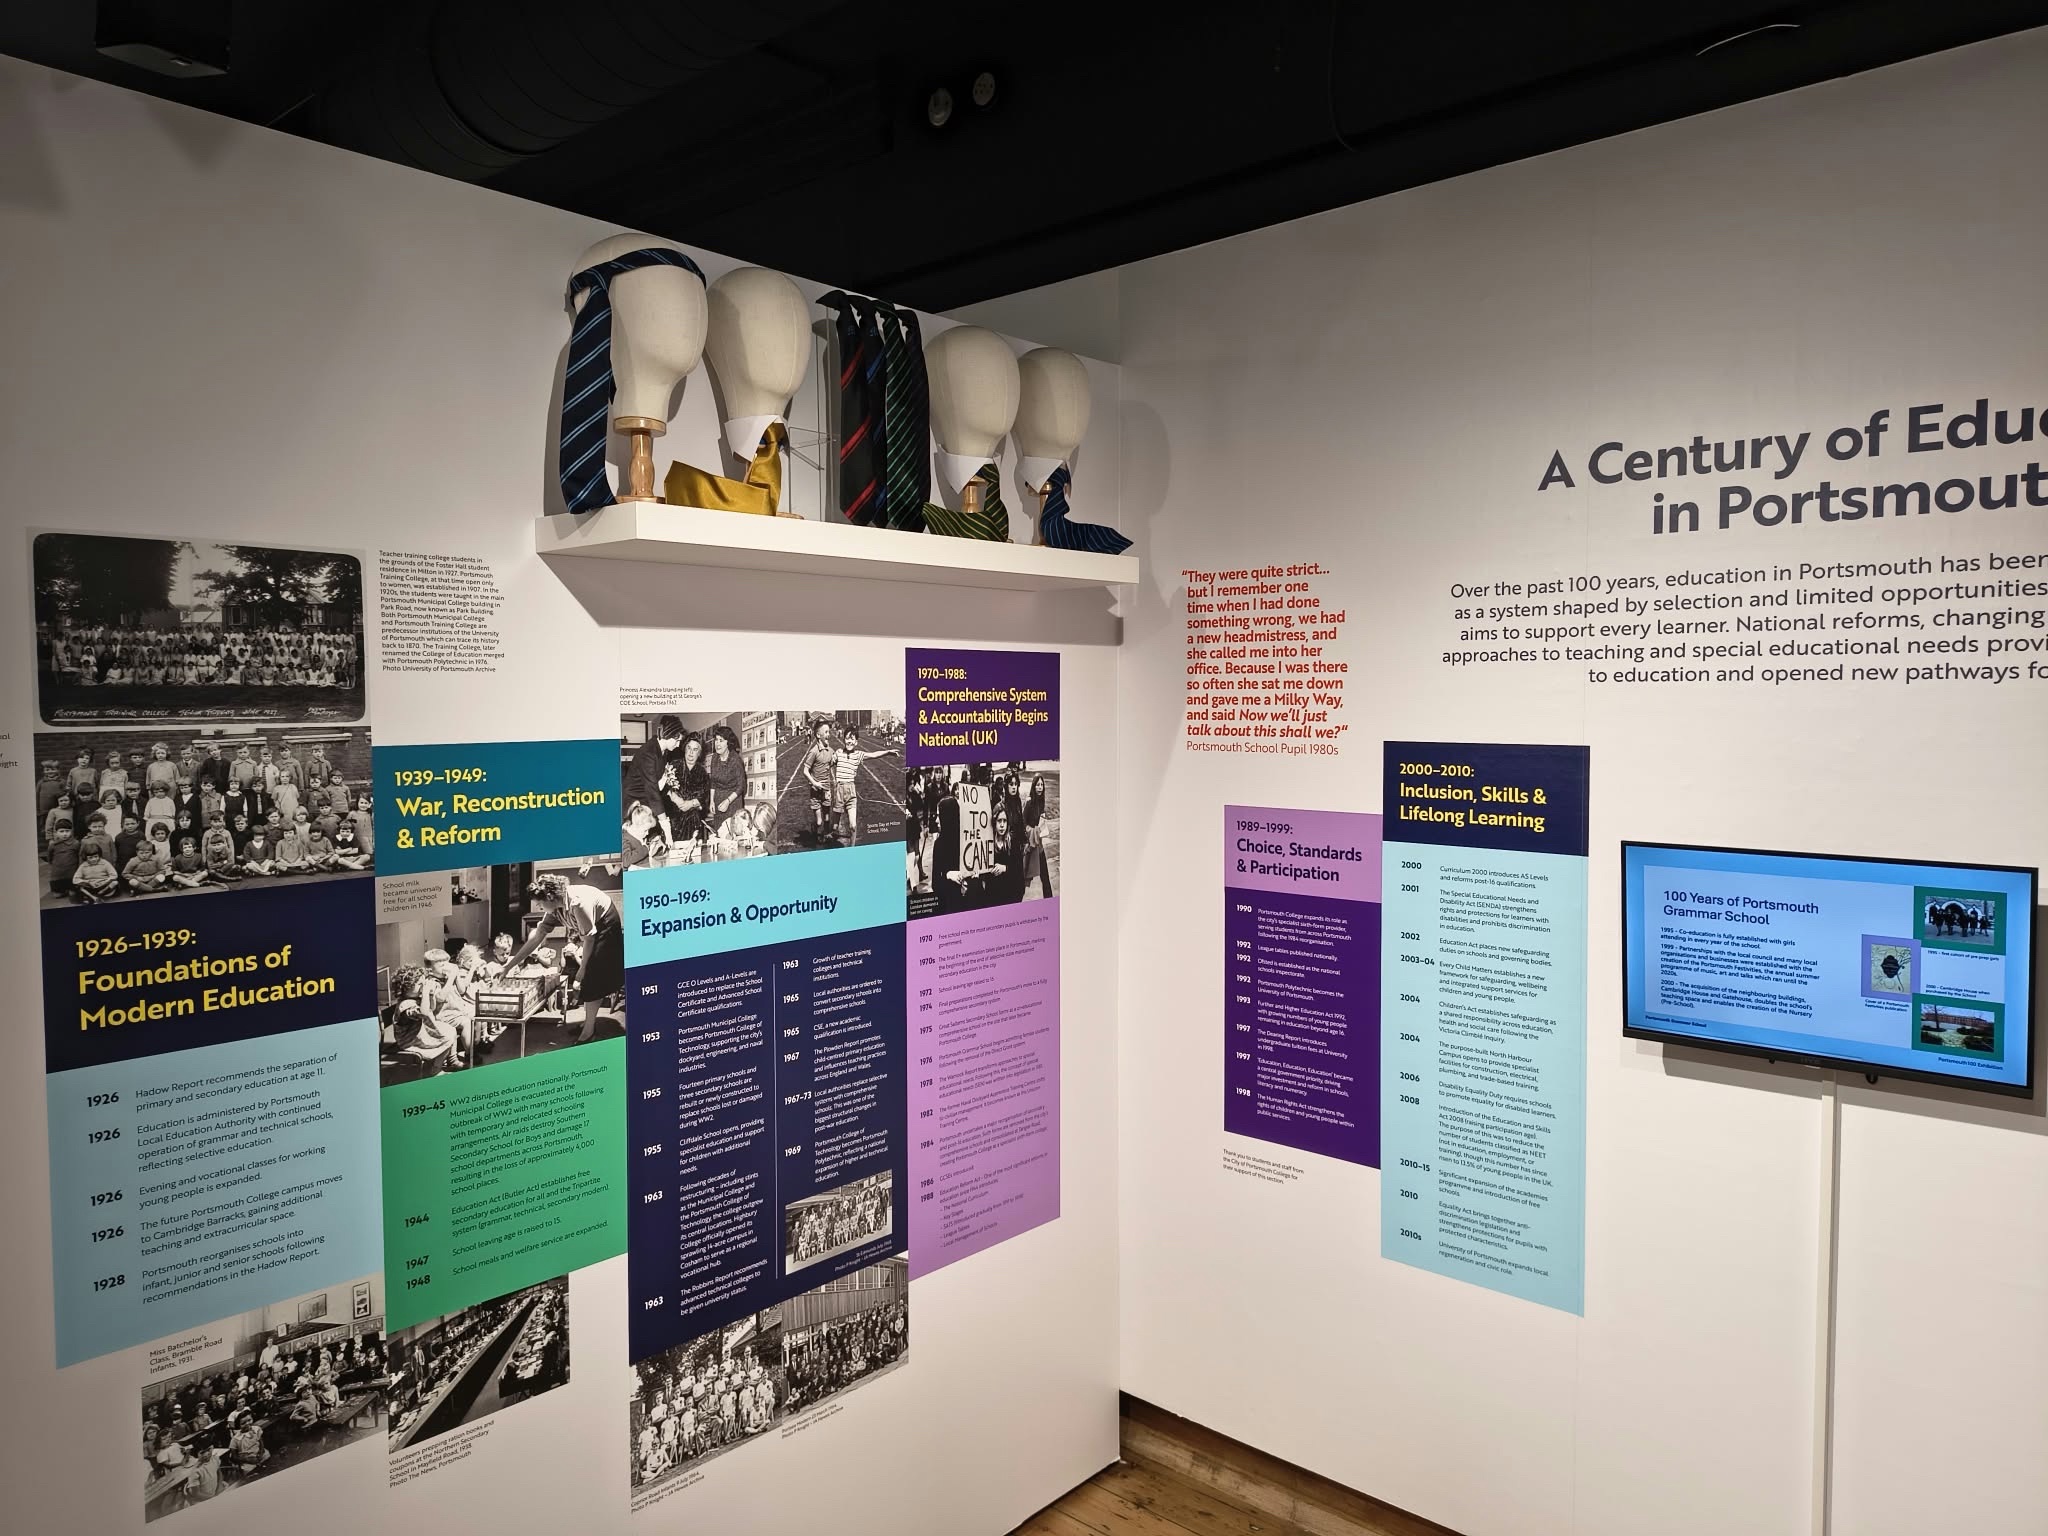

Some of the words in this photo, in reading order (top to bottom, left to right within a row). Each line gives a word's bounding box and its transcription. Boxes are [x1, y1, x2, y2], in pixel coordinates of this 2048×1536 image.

[1538, 450, 1575, 490] A
[1588, 434, 1811, 483] Century
[1826, 410, 1890, 460] of
[1908, 399, 2048, 452] Edu
[1654, 493, 1699, 534] in
[1719, 464, 2048, 527] Portsmout
[1219, 570, 1248, 580] were
[1251, 566, 1283, 581] quite
[1451, 584, 1490, 598] Over
[1494, 582, 1521, 596] the
[1528, 580, 1563, 598] past
[1569, 576, 1601, 592] 100
[1606, 577, 1658, 594] years,
[1666, 568, 1765, 586] education
[1774, 566, 1791, 581] in
[1800, 557, 1931, 579] Portsmouth
[1941, 556, 1980, 572] has
[1188, 586, 1208, 598] but
[1211, 585, 1214, 597] I
[1218, 582, 1282, 596] remember
[1285, 582, 1308, 592] one
[1455, 609, 1470, 619] as
[1476, 608, 1484, 619] a
[1490, 604, 1547, 622] system
[1554, 598, 1618, 618] shaped
[1626, 597, 1648, 616] by
[1654, 594, 1742, 611] selection
[1750, 590, 1788, 607] and
[1797, 586, 1872, 605] limited
[1882, 580, 2048, 605] opportunities
[1188, 615, 1250, 629] something
[1253, 616, 1295, 628] wrong,
[1298, 615, 1317, 624] we
[1321, 610, 1345, 623] had
[1461, 627, 1497, 640] aims
[1502, 627, 1519, 640] to
[1525, 624, 1595, 642] support
[1600, 624, 1651, 639] every
[1658, 620, 1729, 634] learner.
[1737, 614, 1825, 632] National
[1833, 612, 1924, 629] reforms,
[1933, 608, 2045, 629] changing
[1187, 635, 1193, 644] a
[1197, 634, 1221, 644] new
[1224, 630, 1308, 642] headmistress,
[1312, 627, 1336, 640] and
[918, 668, 966, 679] 1970–1988:
[1187, 681, 1199, 690] so
[1203, 678, 1234, 690] often
[1238, 677, 1258, 690] she
[1262, 678, 1280, 690] sat
[1284, 680, 1303, 689] me
[1306, 677, 1343, 689] down
[919, 687, 1007, 704] Comprehensive
[1010, 688, 1046, 705] System
[919, 710, 928, 724] &
[930, 709, 1012, 726] Accountability
[1015, 709, 1048, 725] Begins
[919, 732, 969, 746] National
[972, 730, 997, 746] (UK)
[1187, 741, 1242, 752] Portsmouth
[1245, 742, 1278, 753] School
[1281, 743, 1306, 756] Pupil
[1310, 744, 1338, 755] 1980s
[395, 768, 486, 786] 1939–1949:
[1400, 764, 1474, 777] 2000–2010:
[396, 797, 446, 816] War,
[454, 788, 604, 813] Reconstruction
[963, 786, 978, 804] NO
[1401, 783, 1477, 803] Inclusion,
[1482, 786, 1528, 803] Skills
[1533, 789, 1546, 804] &
[969, 811, 988, 829] TO
[1237, 821, 1292, 834] 1989–1999:
[1400, 806, 1464, 827] Lifelong
[1470, 809, 1544, 832] Learning
[397, 830, 414, 848] &
[422, 826, 500, 846] Reform
[964, 829, 981, 840] THE
[963, 840, 994, 871] CANE
[1237, 838, 1285, 857] Choice,
[1290, 842, 1362, 861] Standards
[1237, 858, 1246, 872] &
[1251, 860, 1339, 881] Participation
[1402, 861, 1422, 869] 2000
[1440, 866, 1471, 874] Curriculum
[640, 890, 710, 909] 1950–1969:
[1664, 891, 1687, 902] 100
[1690, 892, 1724, 905] Years
[1727, 896, 1740, 906] of
[1743, 897, 1818, 913] Portsmouth
[642, 912, 726, 938] Expansion
[730, 907, 742, 923] &
[746, 896, 837, 923] Opportunity
[1664, 905, 1722, 920] Grammar
[1725, 911, 1770, 924] School
[76, 930, 196, 957] 1926–1939:
[920, 935, 932, 943] 1970
[80, 956, 257, 993] Foundations
[265, 945, 291, 968] of
[678, 981, 690, 989] GCE
[697, 977, 713, 985] Levels
[726, 971, 747, 980] A-Levels
[642, 985, 657, 995] 1951
[81, 999, 194, 1030] Modern
[204, 978, 334, 1011] Education
[136, 1087, 169, 1098] Hadow
[172, 1080, 203, 1091] Report
[206, 1068, 264, 1084] recommends
[267, 1065, 280, 1073] the
[283, 1057, 326, 1070] separation
[329, 1053, 337, 1062] of
[87, 1092, 119, 1107] 1926
[136, 1099, 173, 1112] primary
[176, 1093, 193, 1103] and
[196, 1085, 242, 1099] secondary
[244, 1076, 288, 1090] education
[290, 1073, 298, 1081] at
[300, 1071, 315, 1080] age
[1237, 1088, 1250, 1096] 1998
[452, 1243, 477, 1256] School
[478, 1236, 502, 1248] leaving
[504, 1232, 516, 1240] age
[524, 1222, 544, 1234] raised
[1400, 1228, 1421, 1240] 2010s
[94, 1274, 125, 1291] 1928
[407, 1275, 430, 1290] 1948
[150, 1349, 166, 1357] Miss
[172, 1346, 202, 1358] Bramble
[204, 1338, 222, 1348] Road
